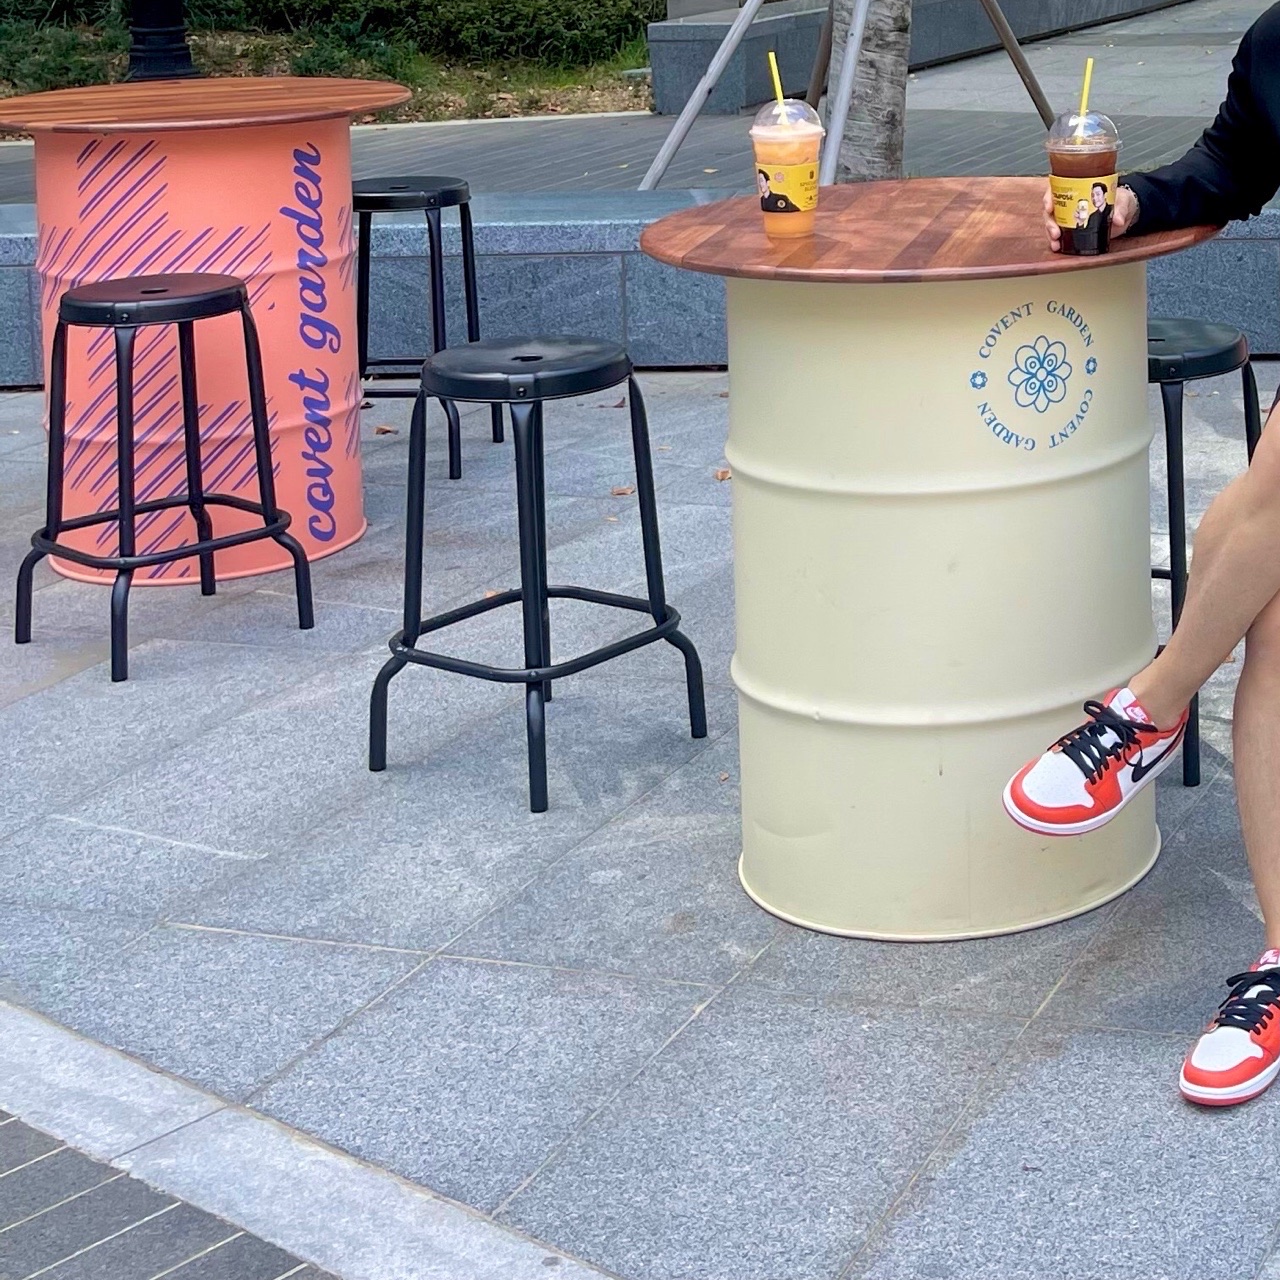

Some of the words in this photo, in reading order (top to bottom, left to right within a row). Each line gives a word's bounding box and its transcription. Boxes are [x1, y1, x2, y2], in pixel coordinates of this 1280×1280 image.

[279, 141, 341, 354] garden
[978, 301, 1034, 359] COVENT
[1046, 300, 1095, 348] GARDEN
[977, 401, 1036, 452] GARDEN
[1048, 388, 1094, 449] COVENT
[288, 367, 337, 542] covent
